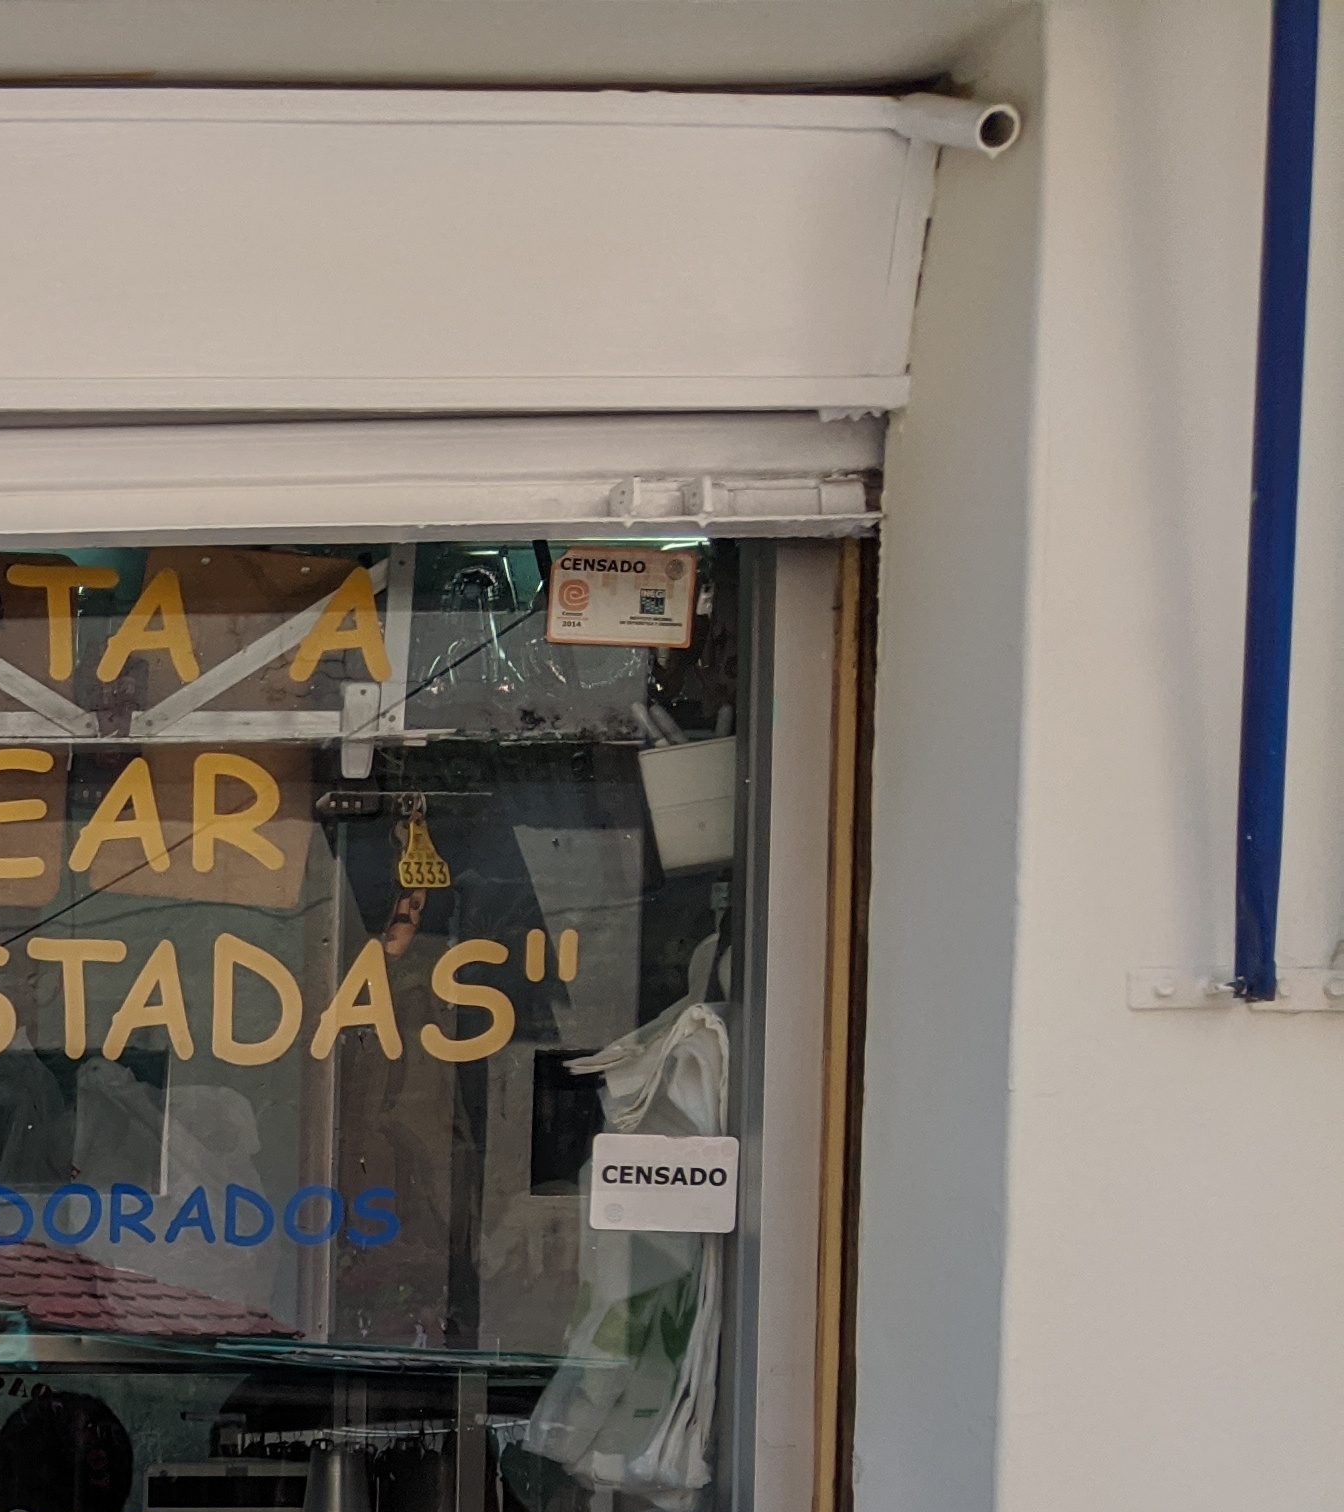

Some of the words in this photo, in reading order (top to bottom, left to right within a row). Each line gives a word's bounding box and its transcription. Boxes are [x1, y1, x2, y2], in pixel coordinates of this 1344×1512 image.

[561, 557, 646, 573] CENSADO
[289, 567, 393, 682] A
[402, 861, 447, 885] 3333
[602, 1164, 728, 1187] CENSADO
